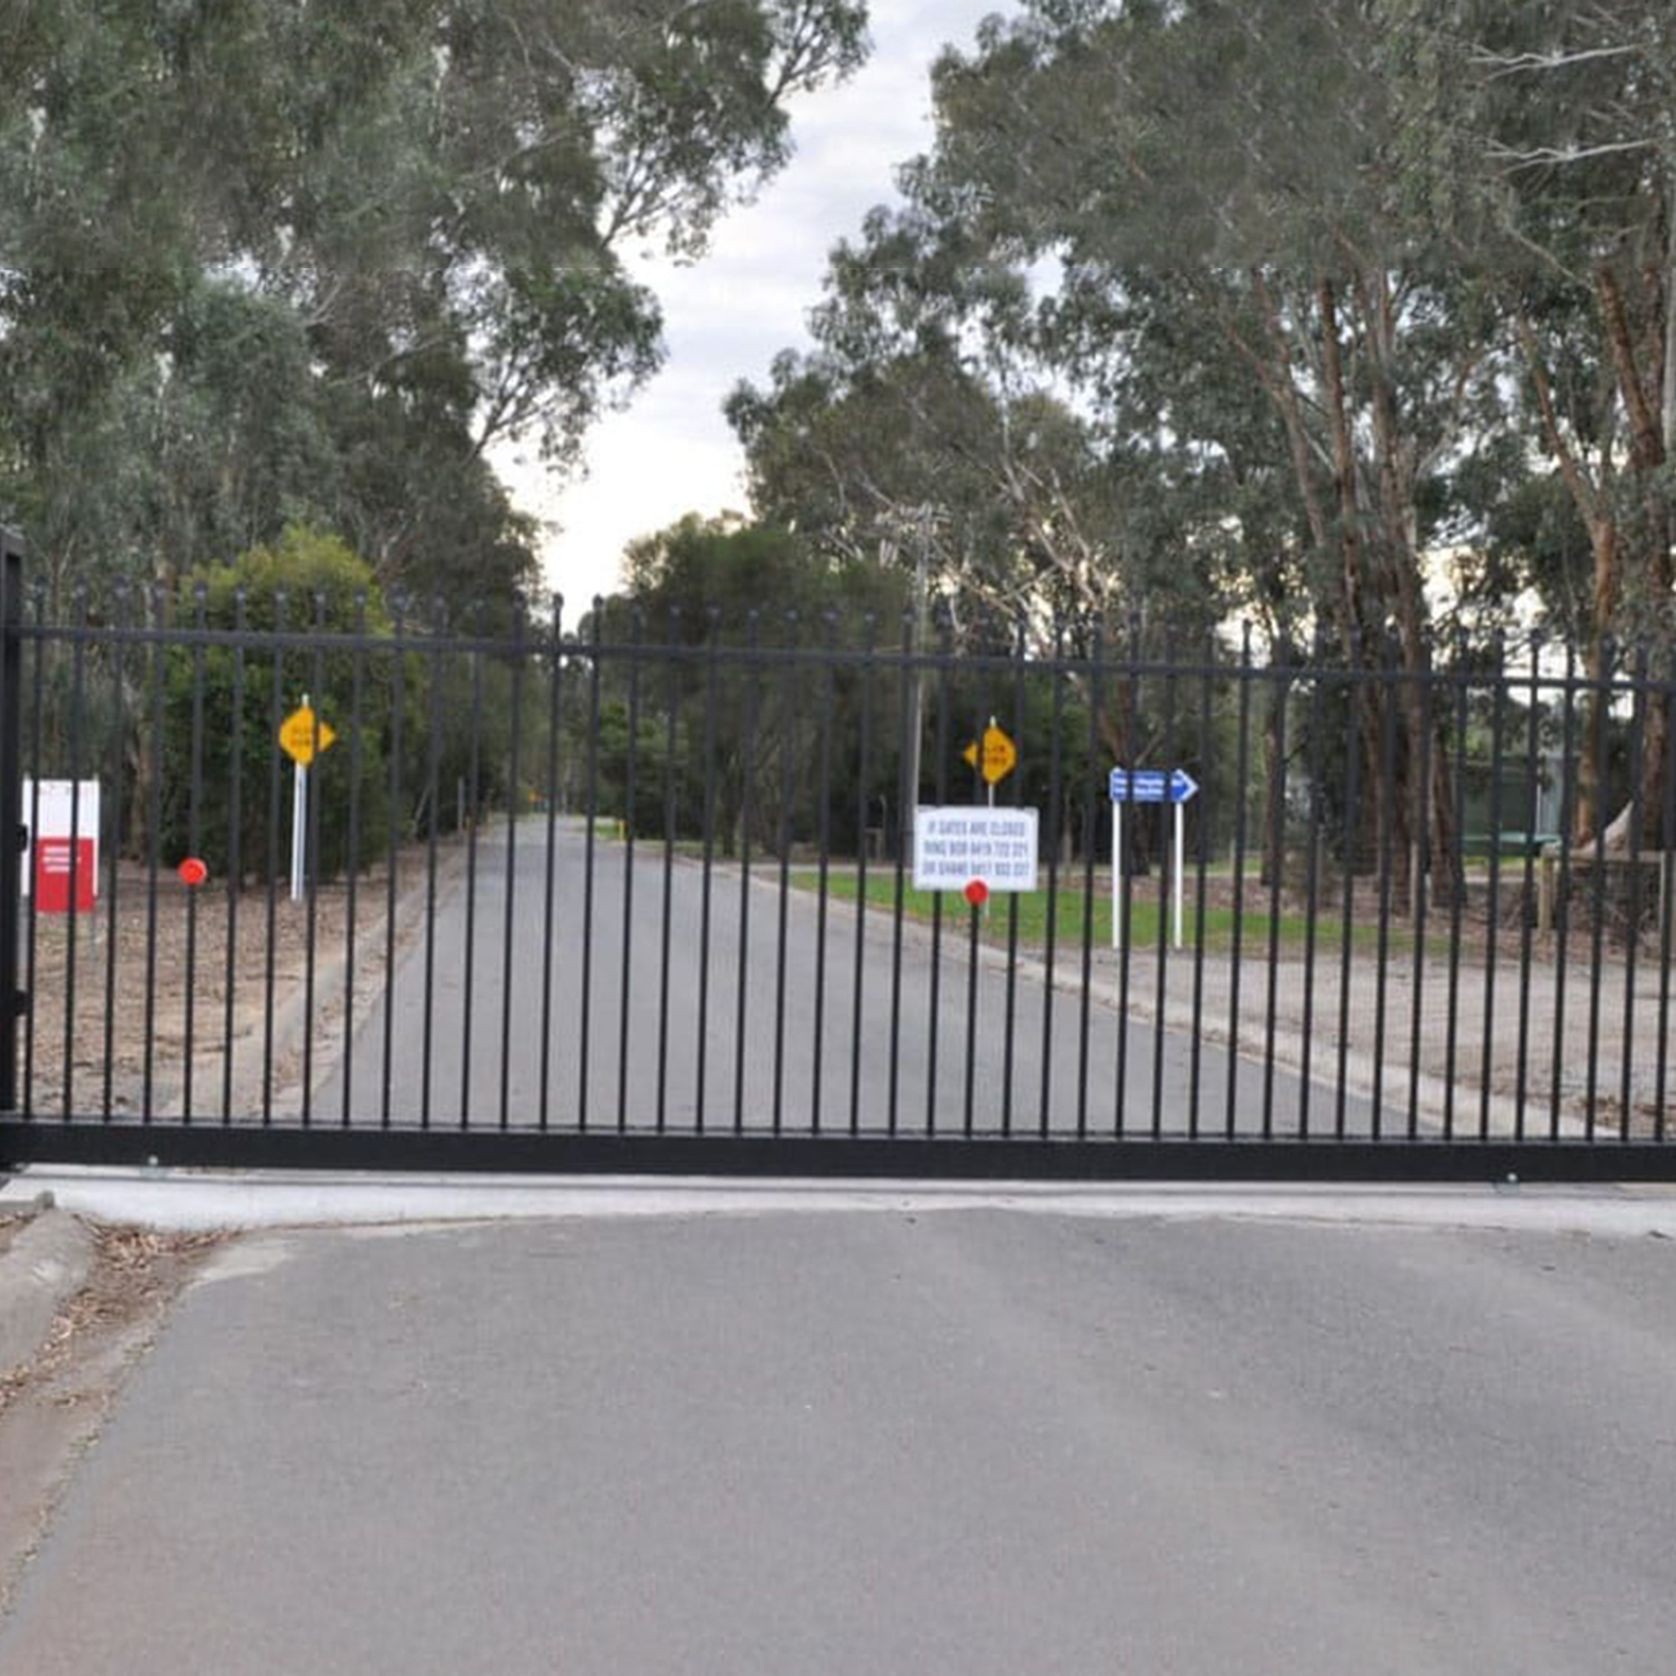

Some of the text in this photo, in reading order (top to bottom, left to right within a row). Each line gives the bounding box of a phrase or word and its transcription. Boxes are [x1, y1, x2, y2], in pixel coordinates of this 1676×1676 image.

[939, 821, 967, 835] GATES
[970, 822, 987, 836] ARE
[990, 822, 1025, 837] CLOSED
[924, 840, 947, 855] RING
[950, 841, 967, 856] BOB
